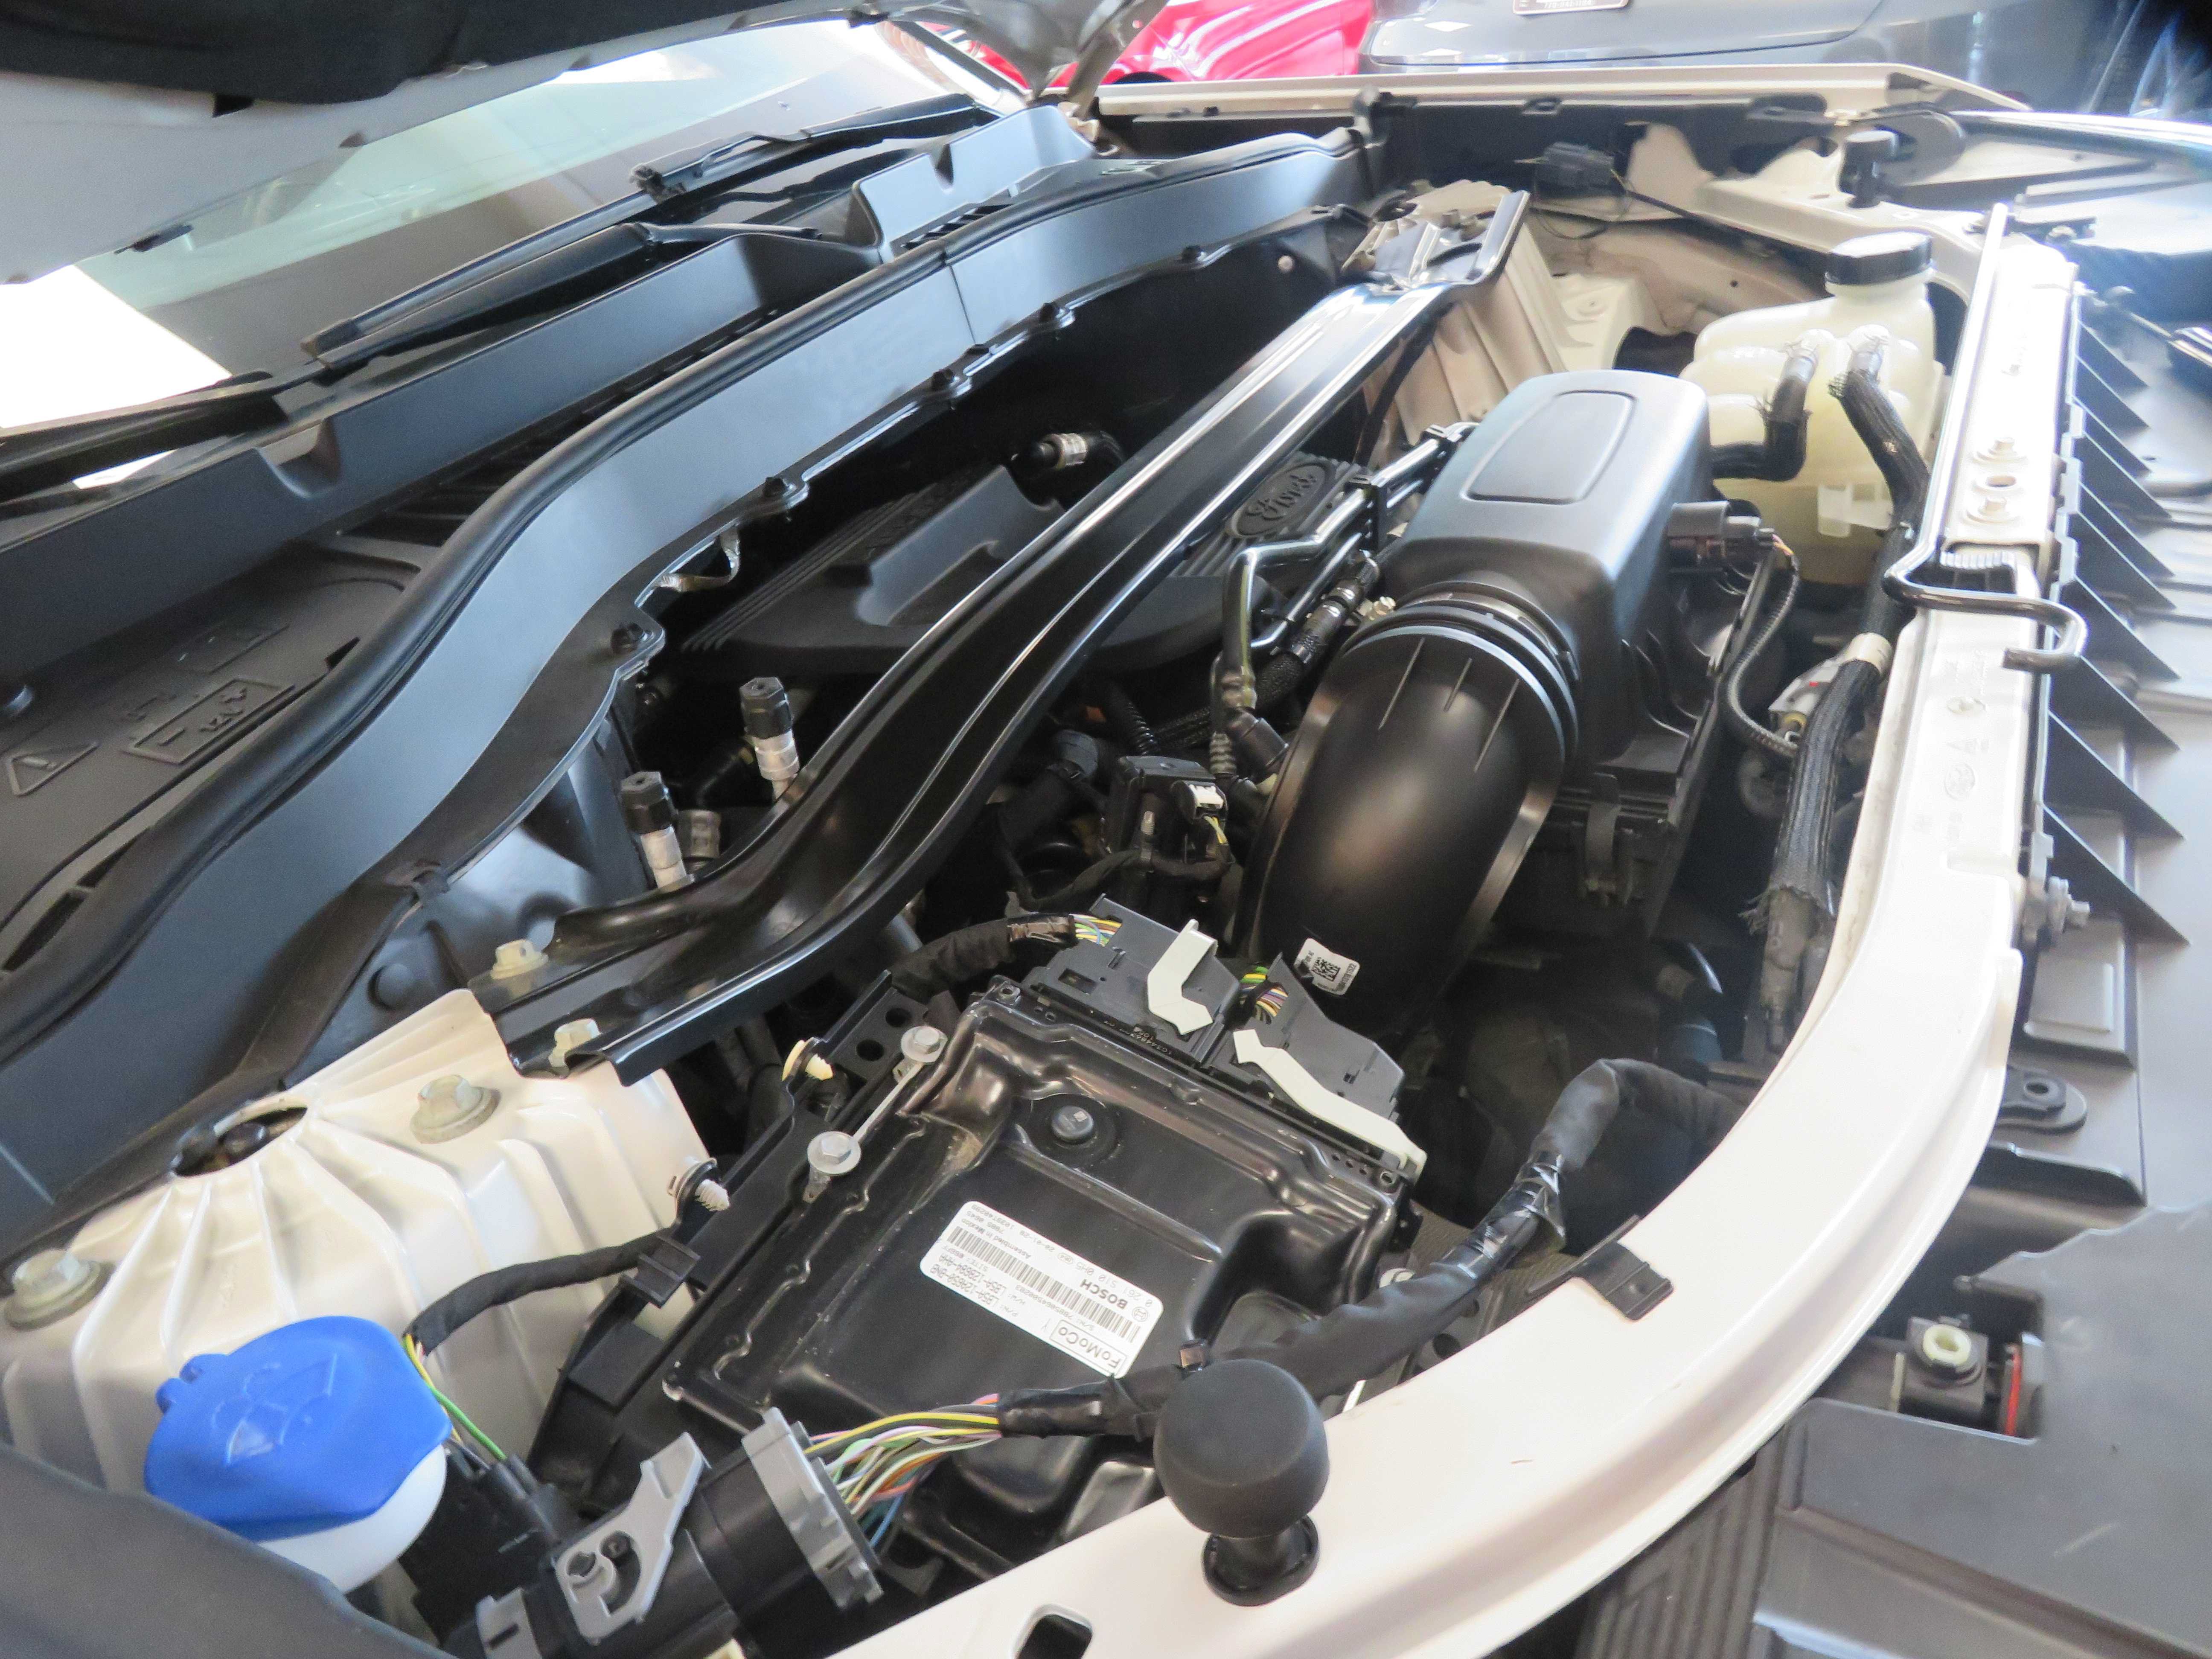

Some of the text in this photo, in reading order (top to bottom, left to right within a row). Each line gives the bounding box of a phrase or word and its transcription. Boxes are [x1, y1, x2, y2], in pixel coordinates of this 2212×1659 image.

[1245, 473, 1317, 521] Ford
[959, 1217, 1032, 1260] Assembled in Mexico
[998, 1304, 1019, 1318] P/N:
[1079, 1278, 1128, 1310] BOSCH
[1075, 1317, 1095, 1331] S/N:
[1054, 1325, 1122, 1369] FoMoCo
